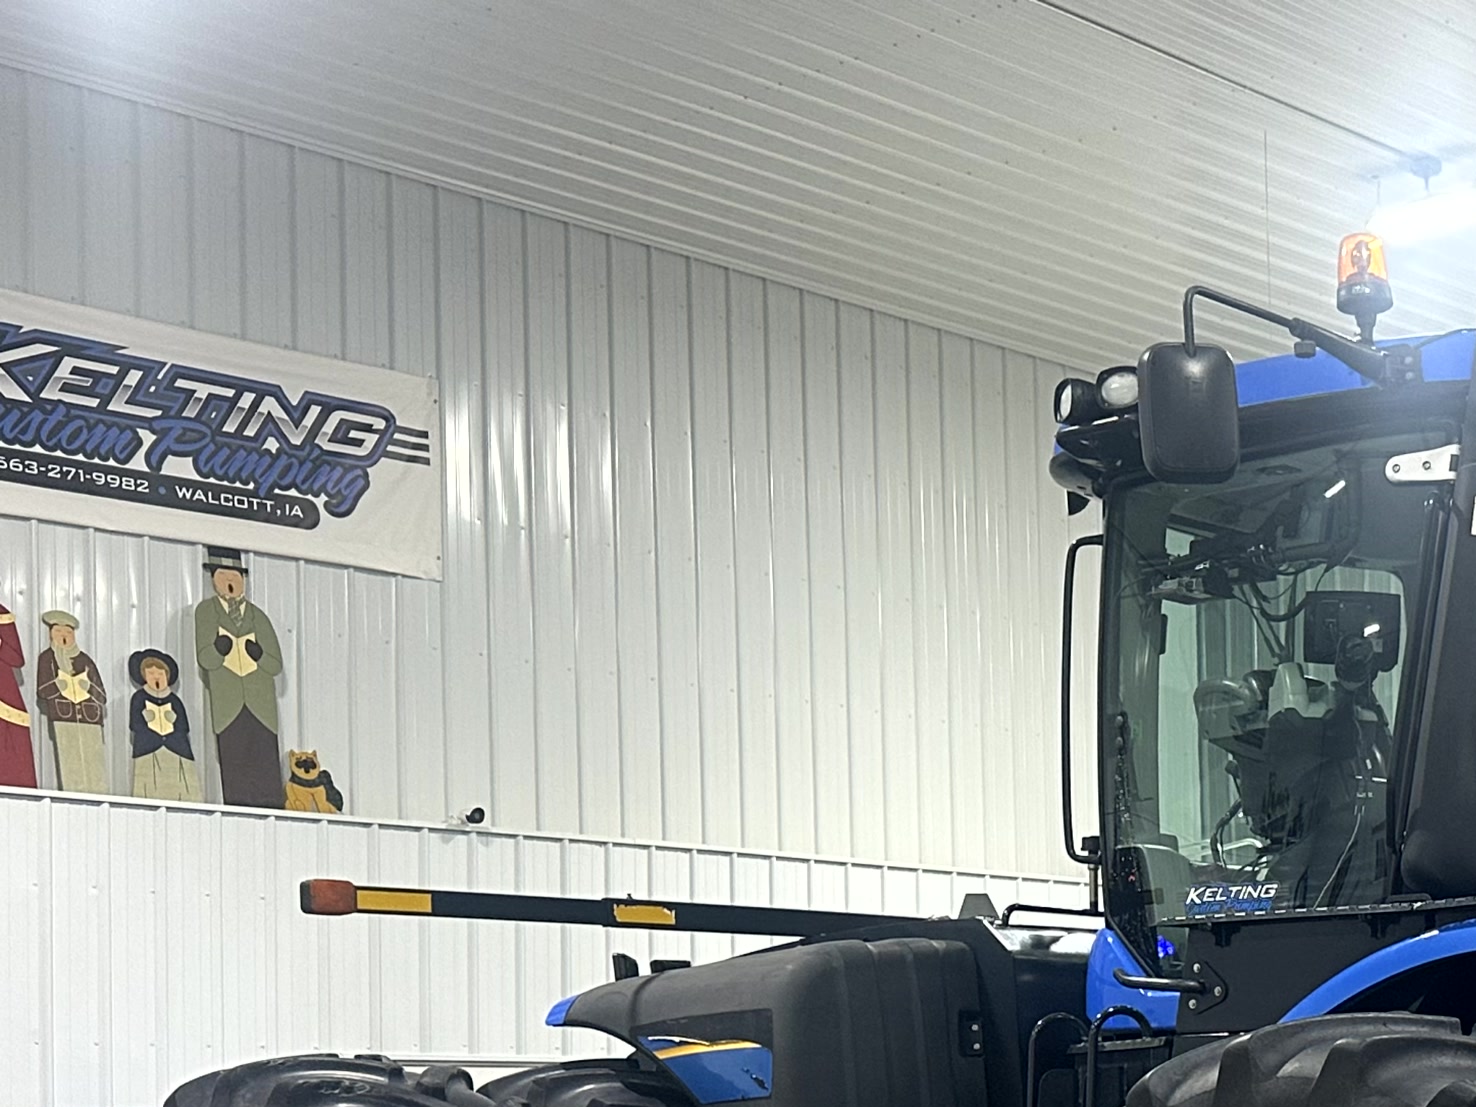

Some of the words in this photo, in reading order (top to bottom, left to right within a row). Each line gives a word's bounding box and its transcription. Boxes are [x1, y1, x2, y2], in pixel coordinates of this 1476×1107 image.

[0, 342, 388, 457] KELTING
[0, 403, 138, 461] ustom
[150, 418, 367, 513] Pumping
[1185, 884, 1279, 905] KELTING
